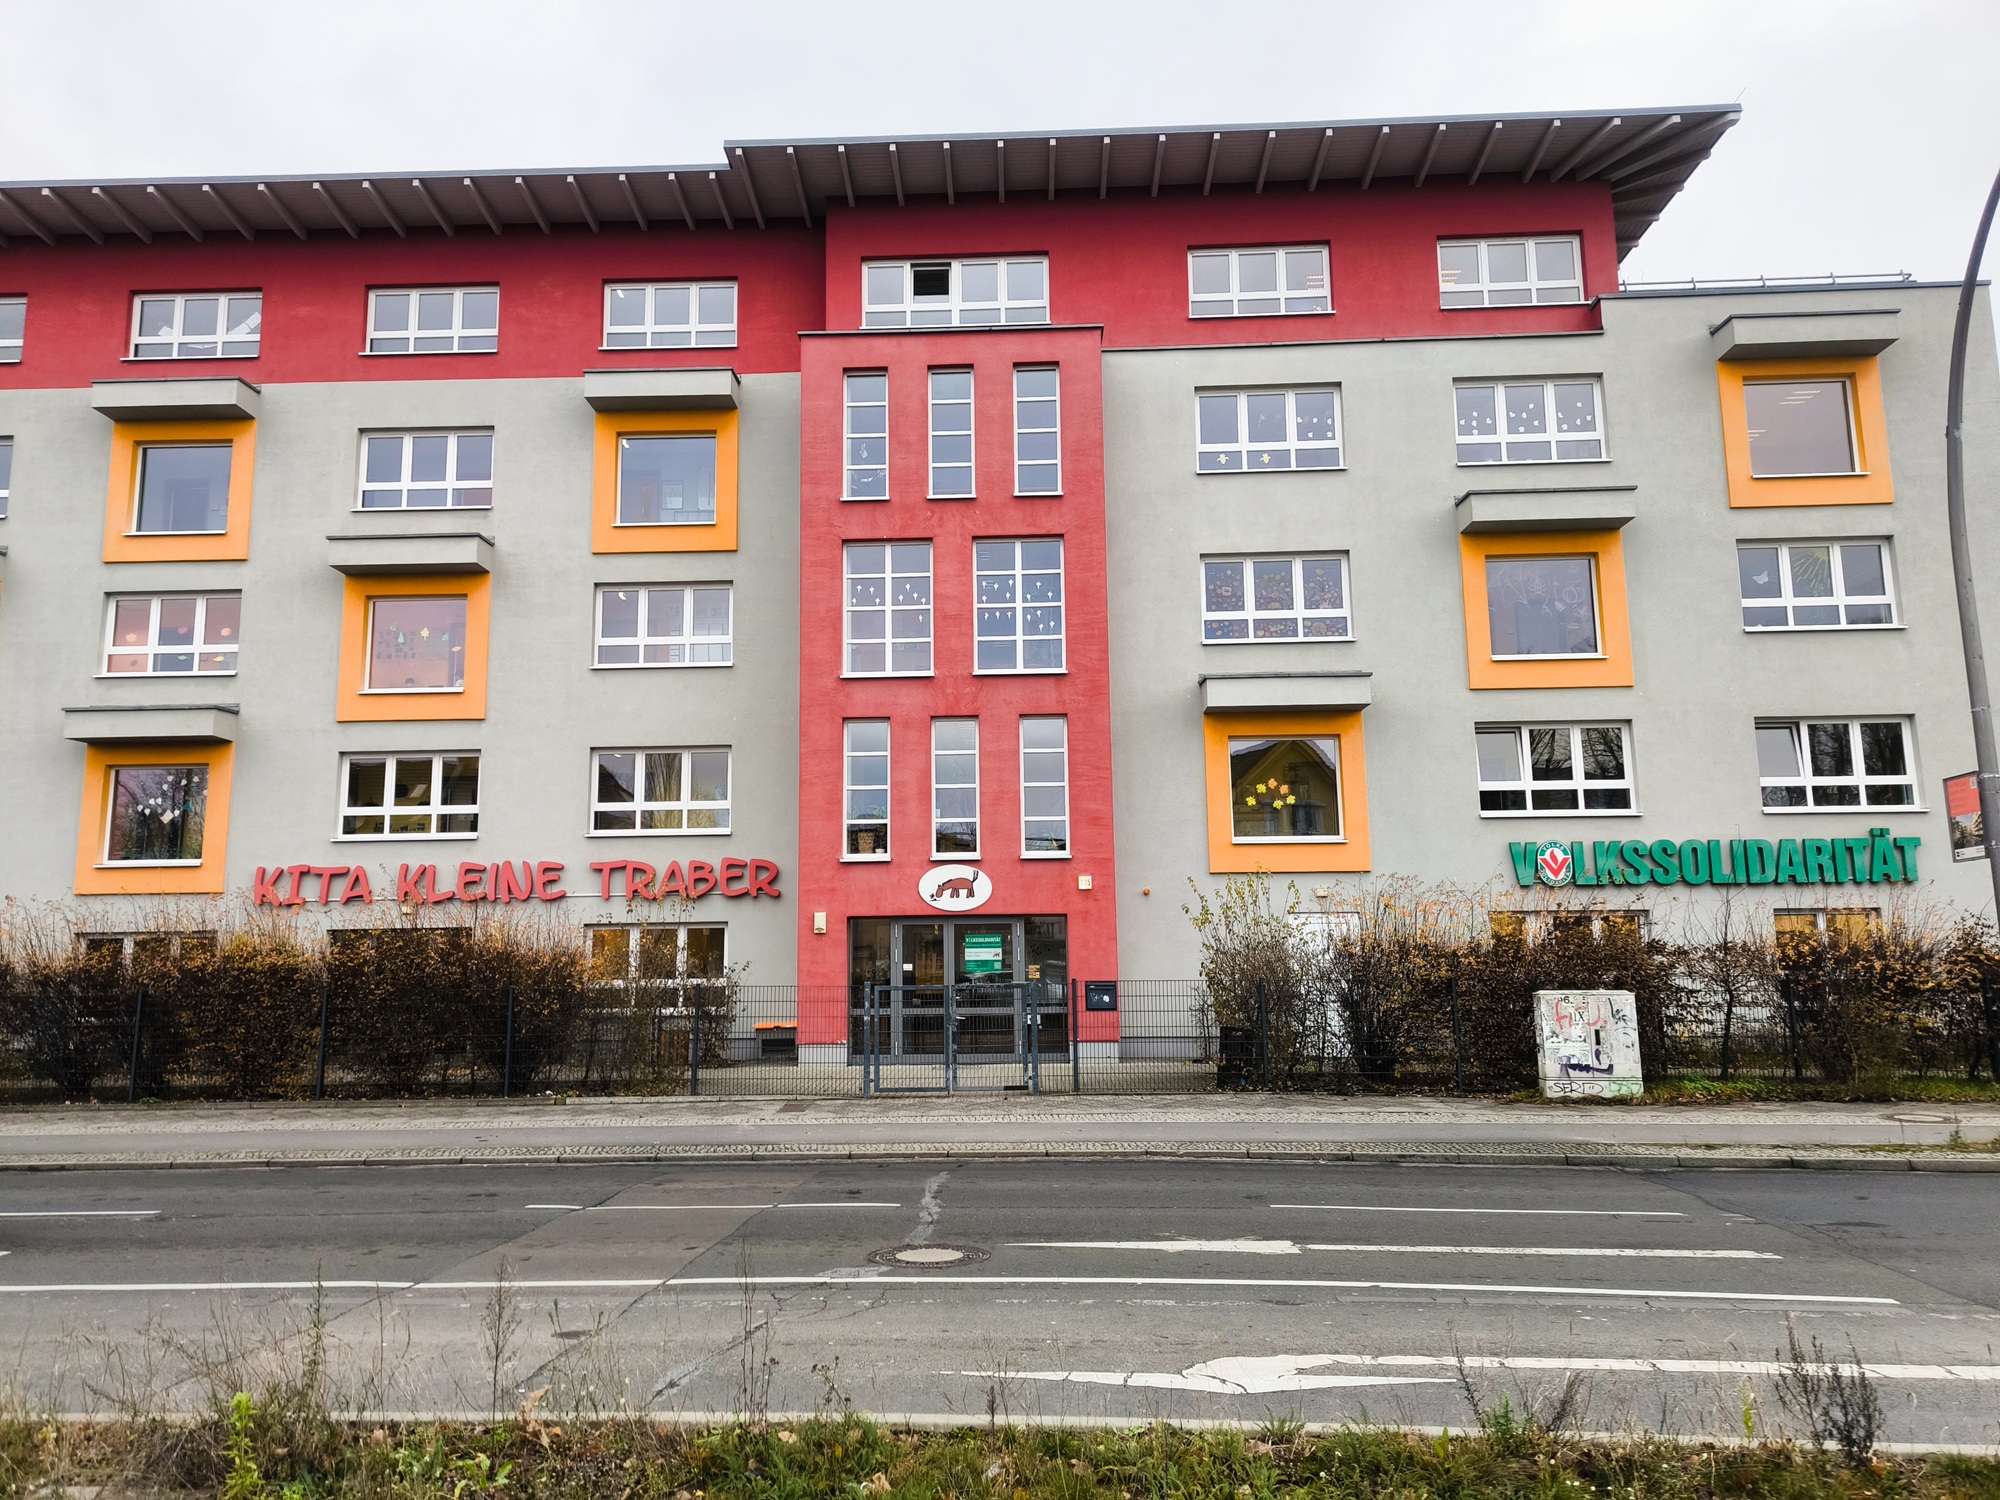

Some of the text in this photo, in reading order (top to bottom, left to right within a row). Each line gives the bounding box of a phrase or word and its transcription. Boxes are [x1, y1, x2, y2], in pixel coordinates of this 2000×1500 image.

[1543, 842, 1565, 851] VOLKS
[253, 857, 781, 908] KITA KLEINE TRABER
